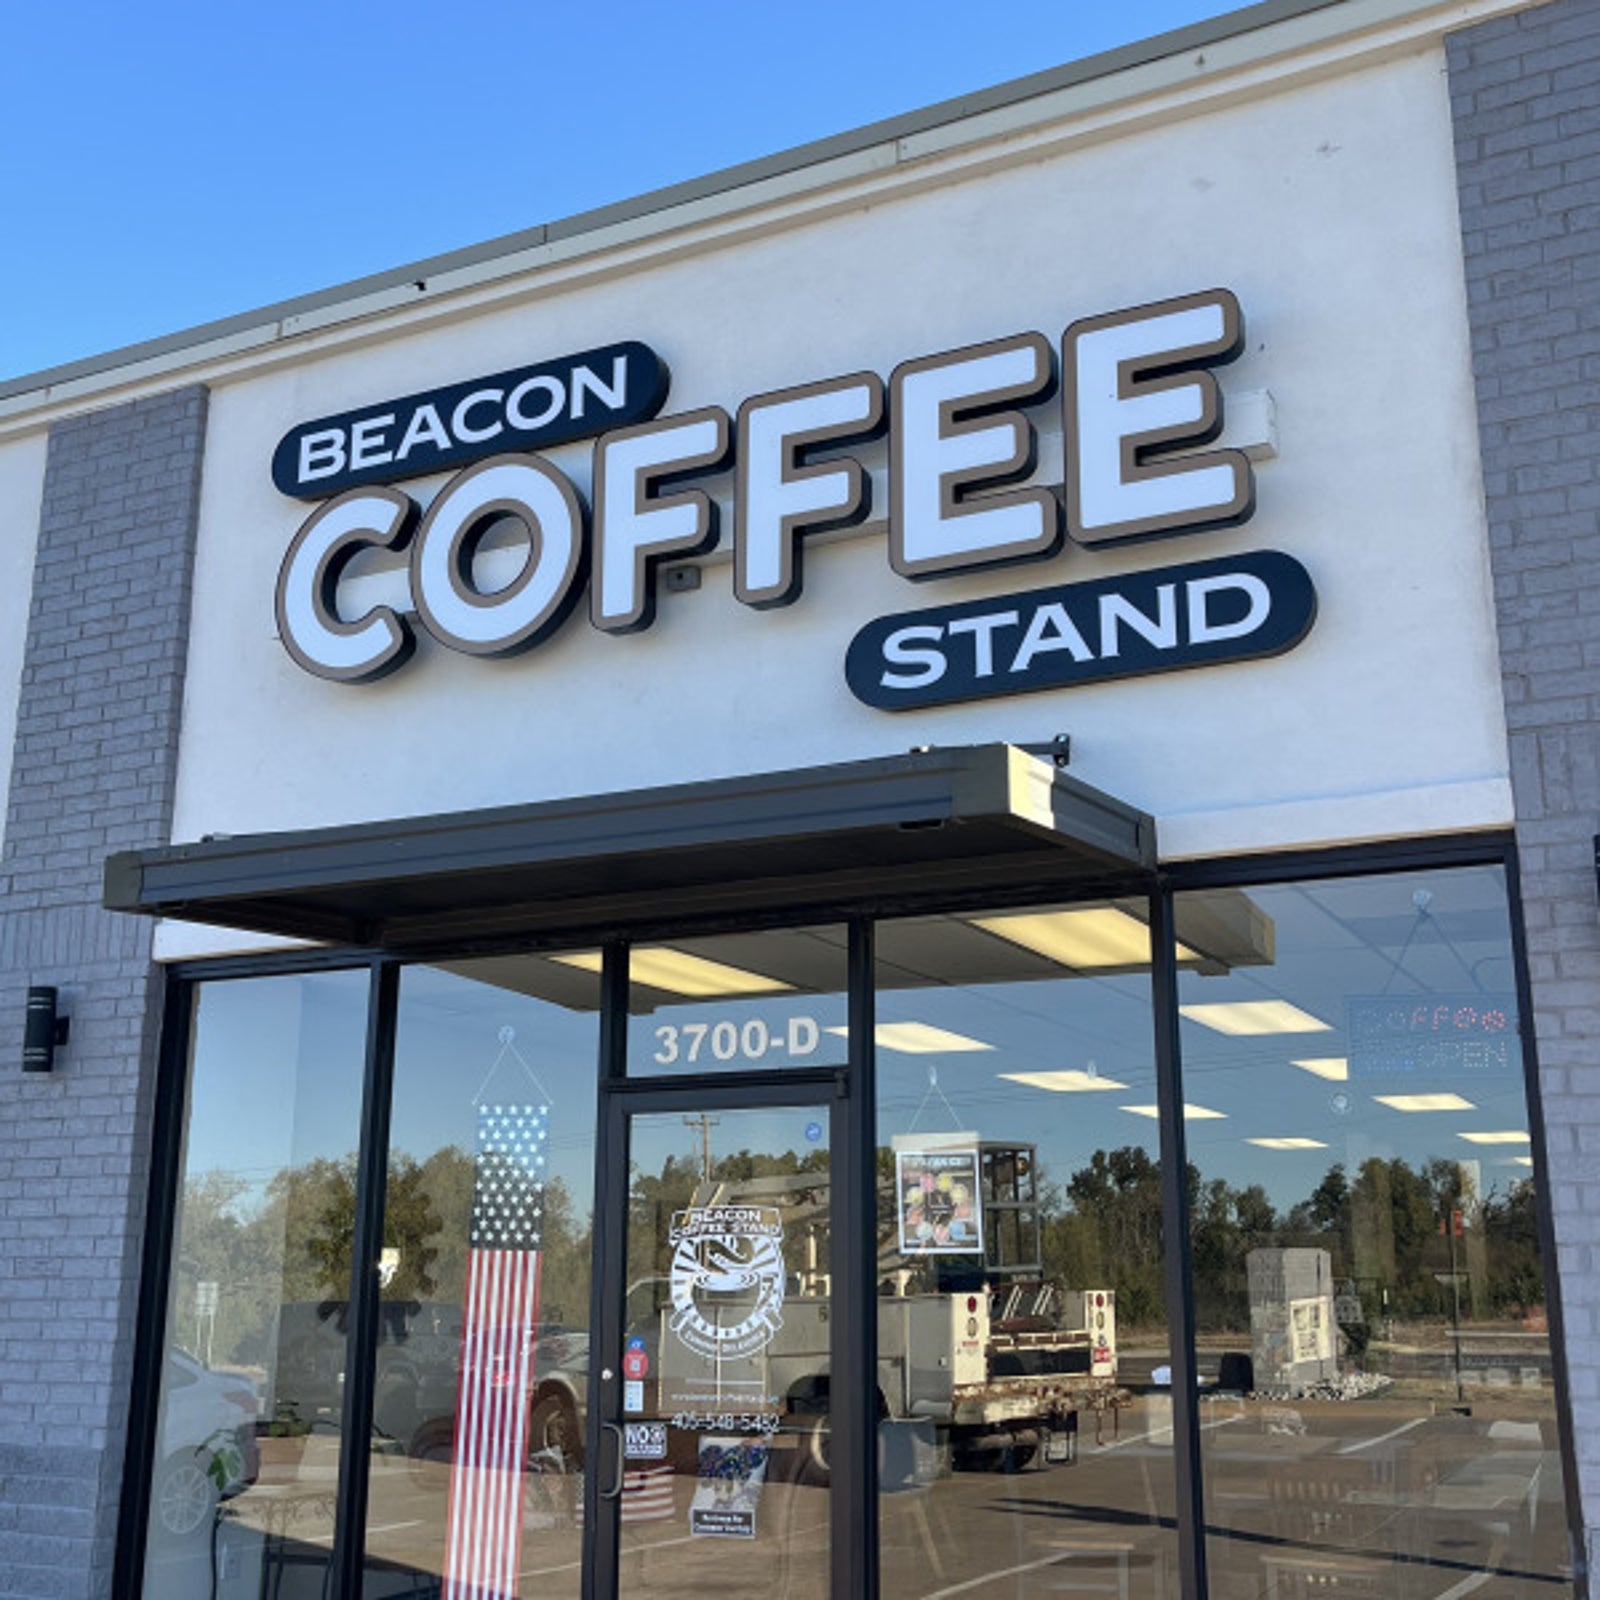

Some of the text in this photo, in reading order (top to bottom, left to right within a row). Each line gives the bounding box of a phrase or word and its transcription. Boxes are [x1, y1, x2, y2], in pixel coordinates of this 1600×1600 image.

[297, 355, 629, 484] BEACON
[274, 287, 1256, 684] COFFEE
[879, 571, 1272, 689] STAND
[653, 1016, 820, 1065] 3700-D
[670, 1221, 780, 1241] COFFEE STAND
[689, 1208, 762, 1224] BEACON
